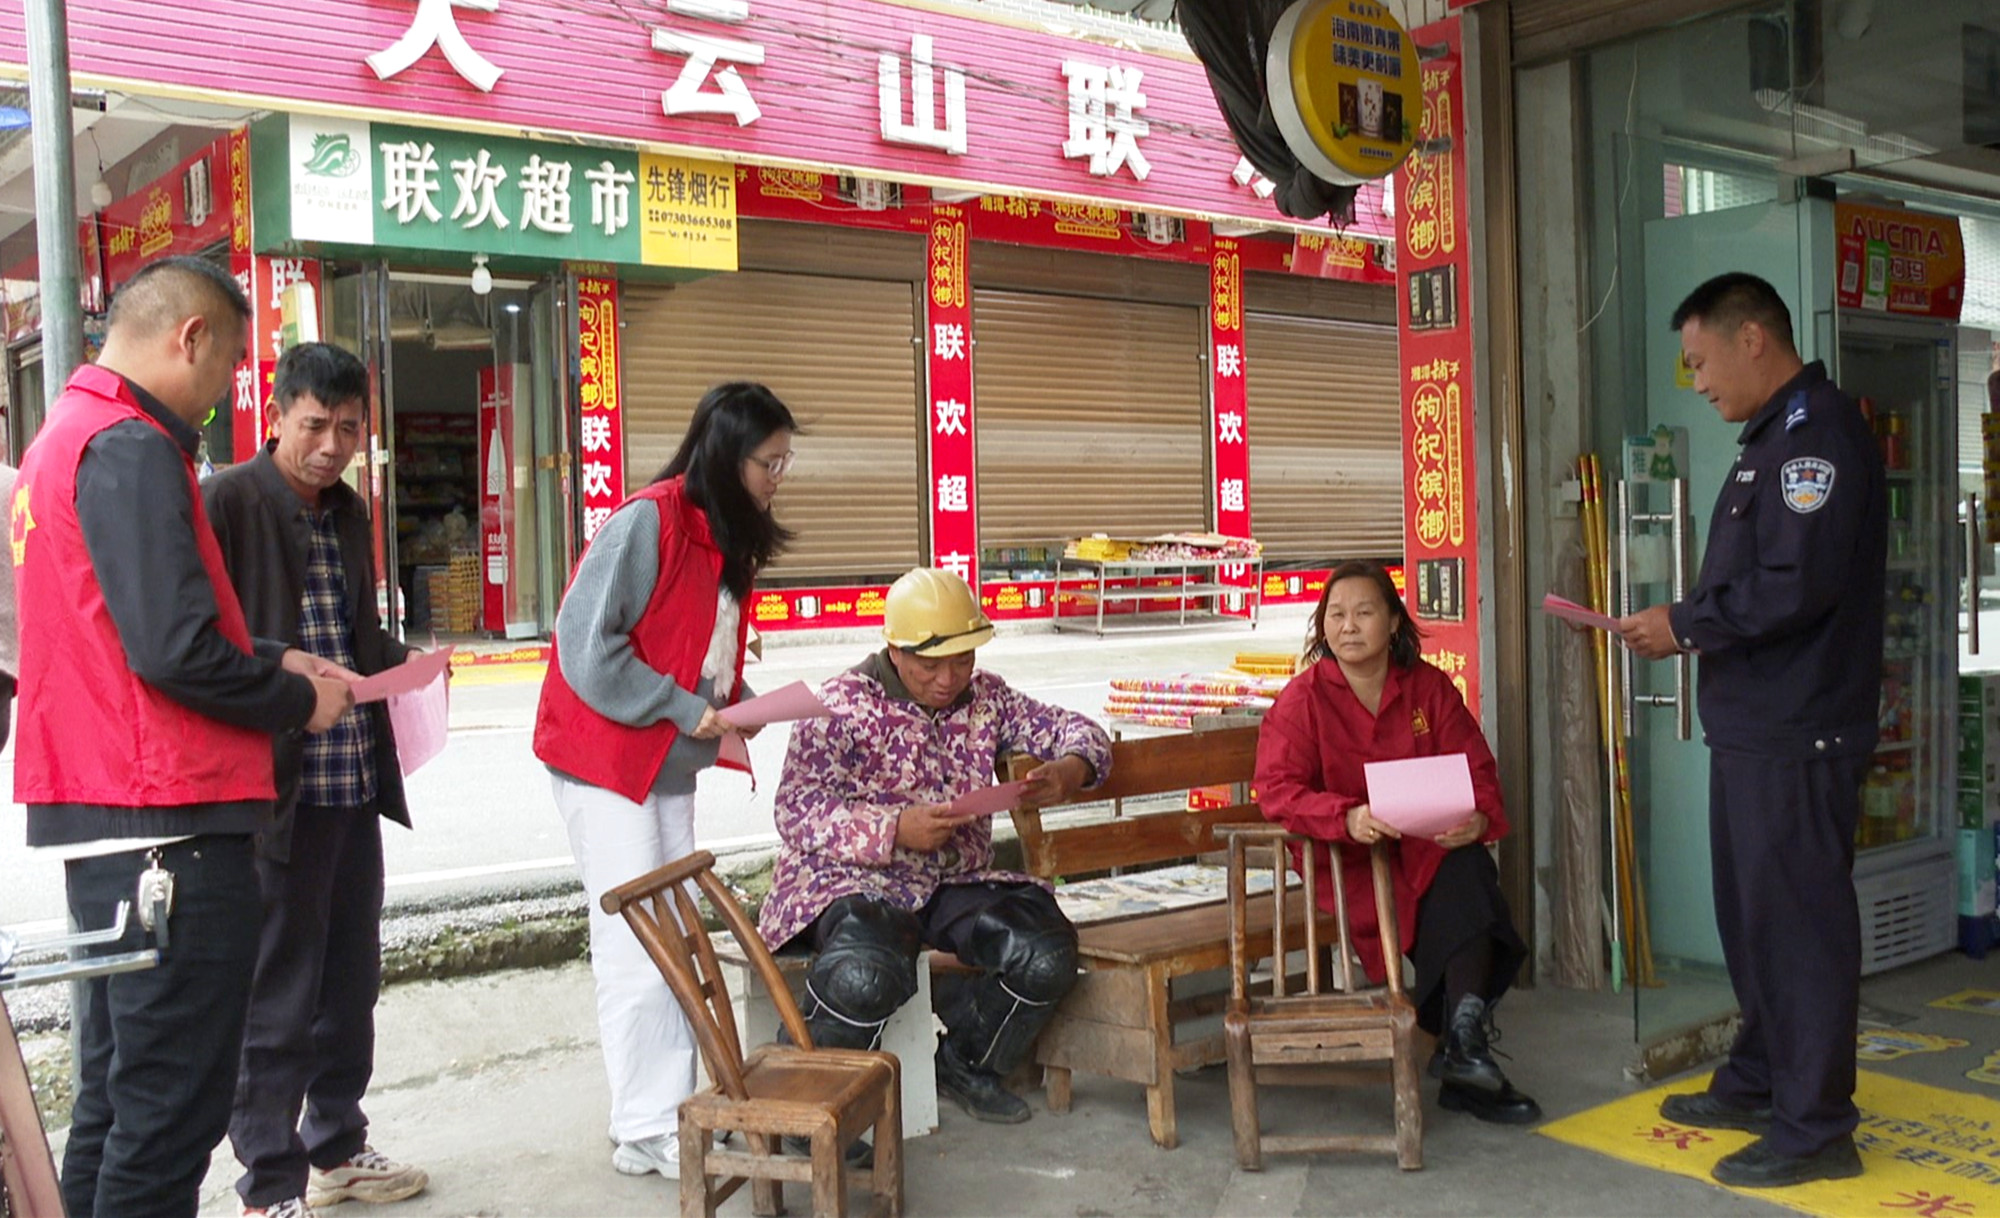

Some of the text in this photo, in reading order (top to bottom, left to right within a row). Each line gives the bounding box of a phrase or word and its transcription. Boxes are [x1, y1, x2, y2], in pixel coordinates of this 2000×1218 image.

[379, 141, 635, 236] 联欢超市
[646, 165, 730, 209] 先锋烟行
[935, 224, 952, 303] 枸杞槟榔
[1852, 216, 1946, 257] AUCMA
[1216, 256, 1230, 326] 枸杞槟榔
[1411, 358, 1460, 382] 湘潭铺子
[1416, 393, 1446, 541] 枸杞槟榔
